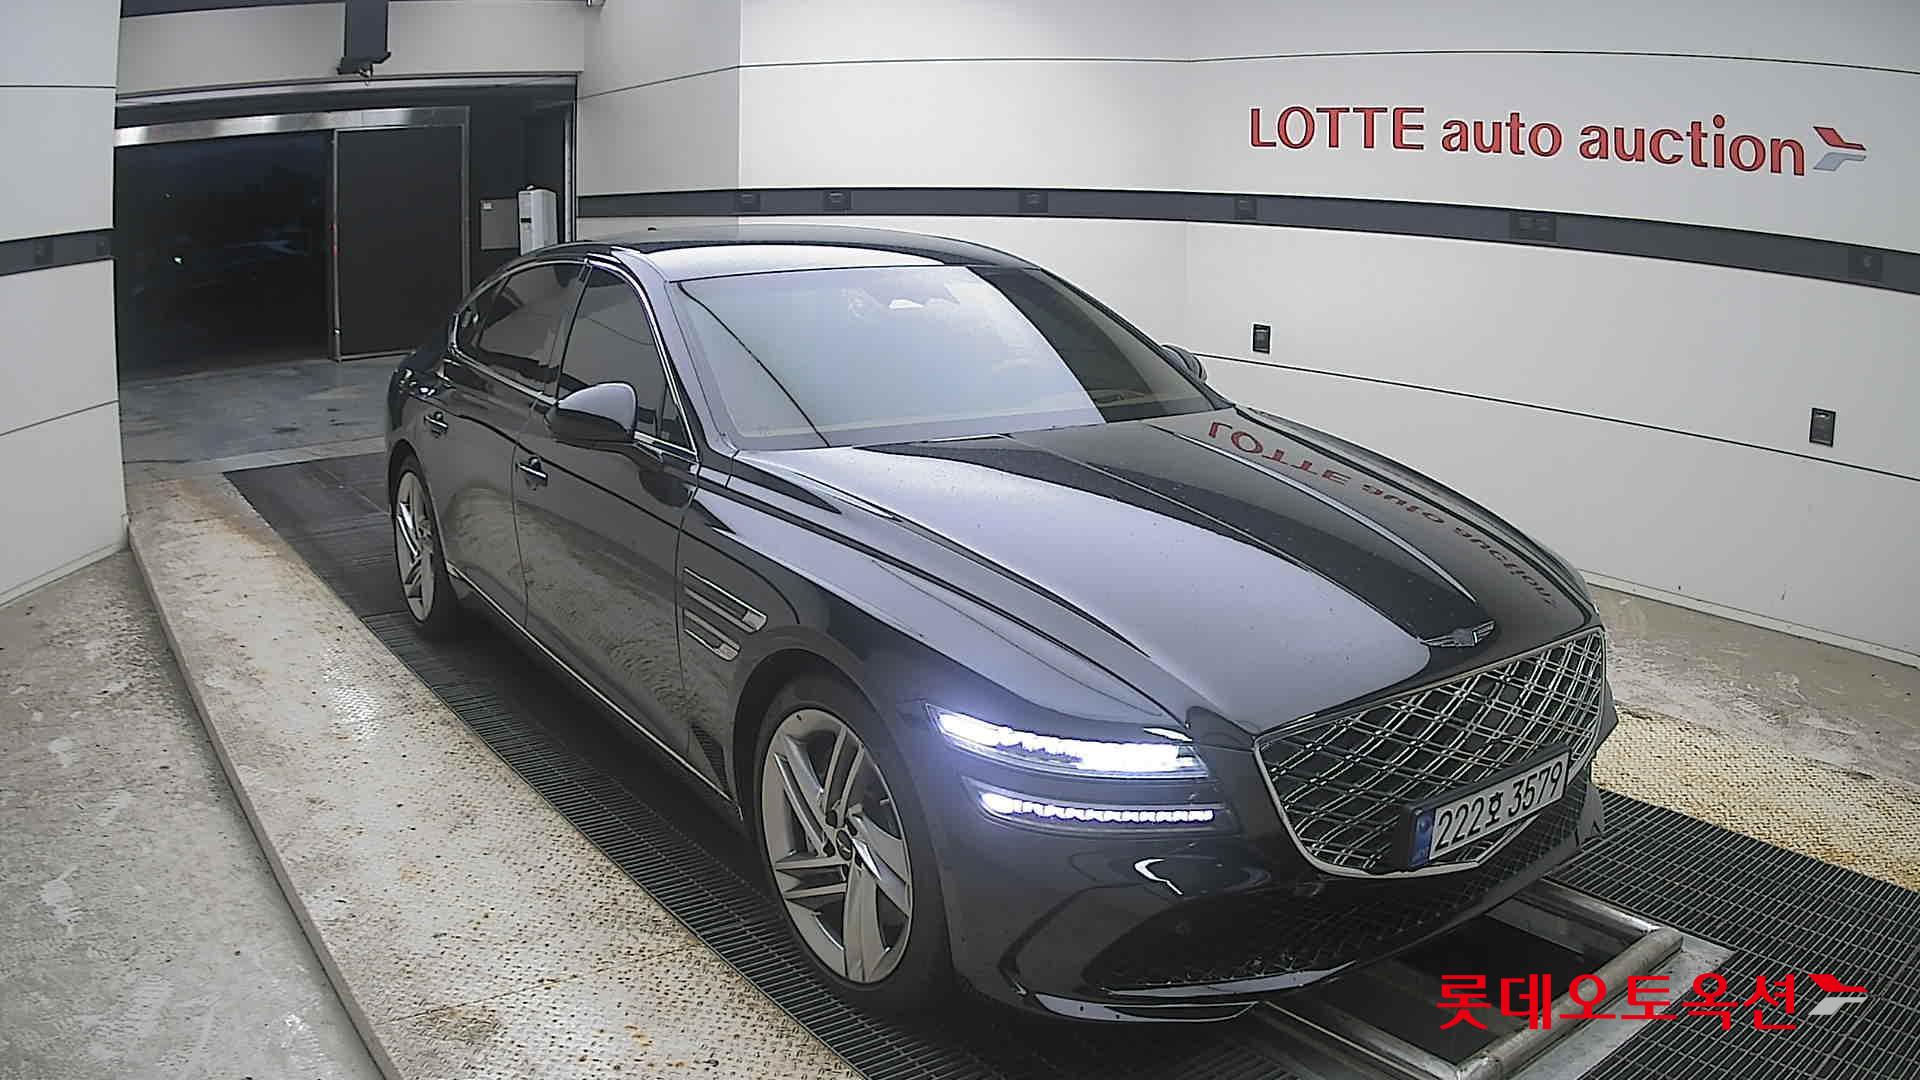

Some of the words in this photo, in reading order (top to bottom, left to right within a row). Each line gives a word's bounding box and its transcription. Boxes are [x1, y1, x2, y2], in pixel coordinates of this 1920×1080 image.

[1249, 106, 1425, 151] LOTTE
[1440, 111, 1562, 158] auto
[1578, 114, 1806, 176] auction
[1508, 761, 1563, 817] 3579
